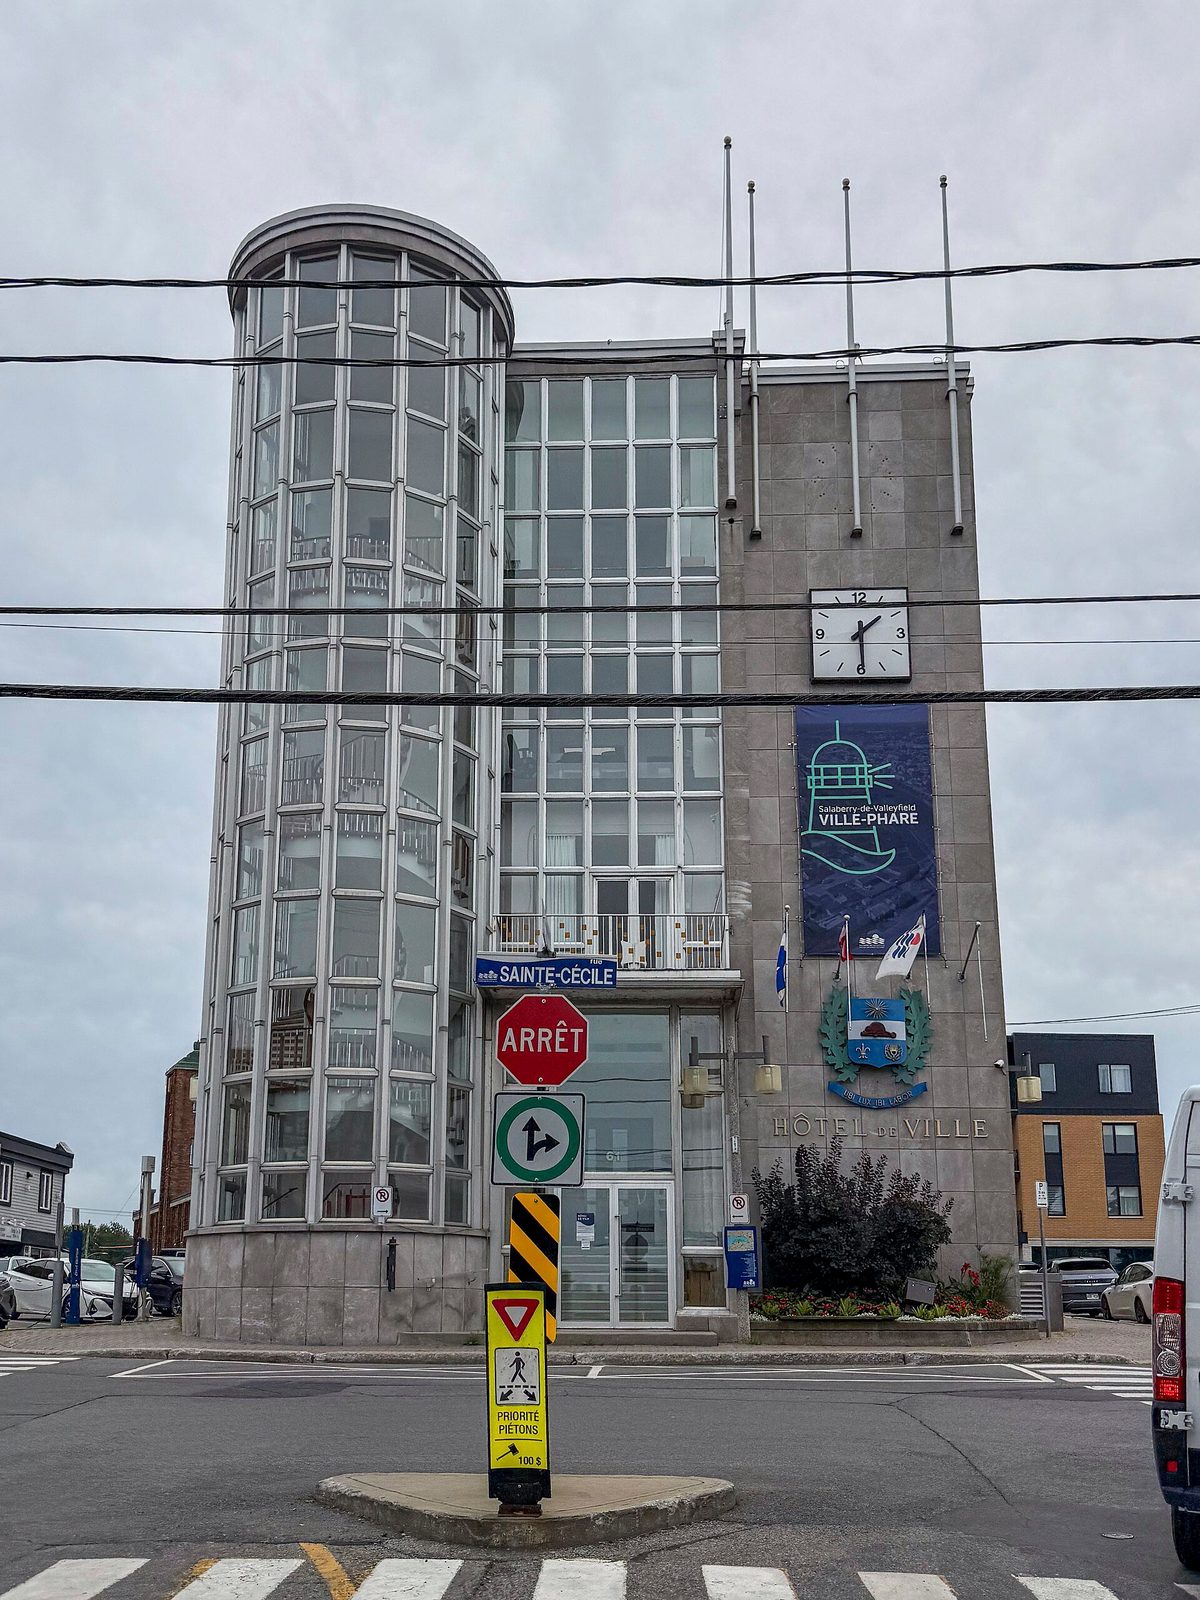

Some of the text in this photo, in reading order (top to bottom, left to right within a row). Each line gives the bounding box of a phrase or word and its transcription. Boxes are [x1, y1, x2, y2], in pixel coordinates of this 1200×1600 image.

[852, 592, 866, 604] 12
[815, 628, 825, 639] 9
[896, 627, 905, 639] 3
[857, 664, 866, 675] 6
[818, 804, 916, 814] Salaberry-de-Valleyfield
[819, 813, 919, 826] VILLE-PHARE
[500, 964, 614, 985] SAINTE-CÉCILE
[501, 1020, 584, 1053] ARRÊT
[843, 1089, 856, 1100] UBI
[889, 1090, 914, 1105] LABOR
[772, 1112, 989, 1138] HÔTEL DE VILLE
[606, 1151, 620, 1161] 61
[497, 1410, 539, 1422] PRIORITÉ
[498, 1422, 539, 1435] PIÉTONS
[518, 1456, 542, 1467] 100 $
